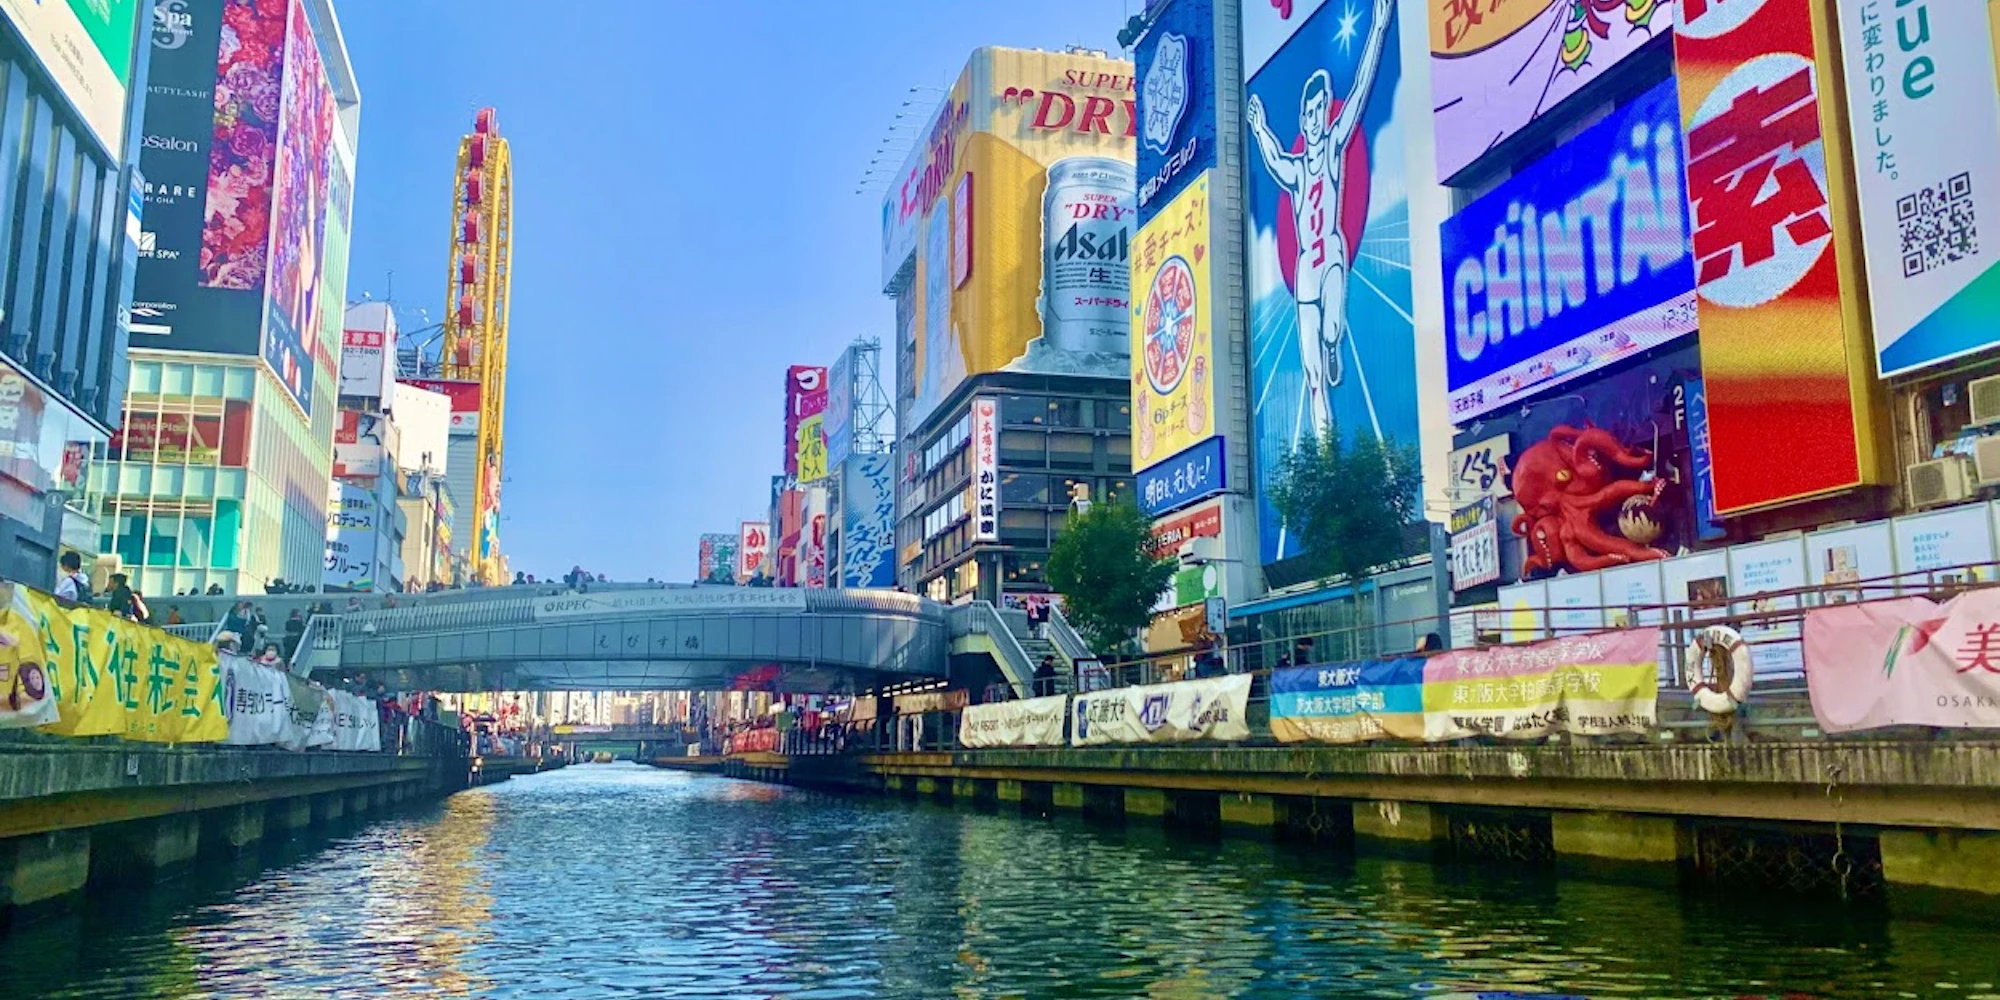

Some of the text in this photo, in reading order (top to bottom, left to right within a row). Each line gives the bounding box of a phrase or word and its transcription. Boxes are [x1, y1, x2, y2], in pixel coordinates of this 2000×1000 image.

[1860, 3, 1899, 182] に変わりました。
[1082, 192, 1118, 204] SUPER
[1307, 174, 1326, 269] グリコ
[1089, 267, 1112, 285] 生
[1955, 622, 2000, 673] 美
